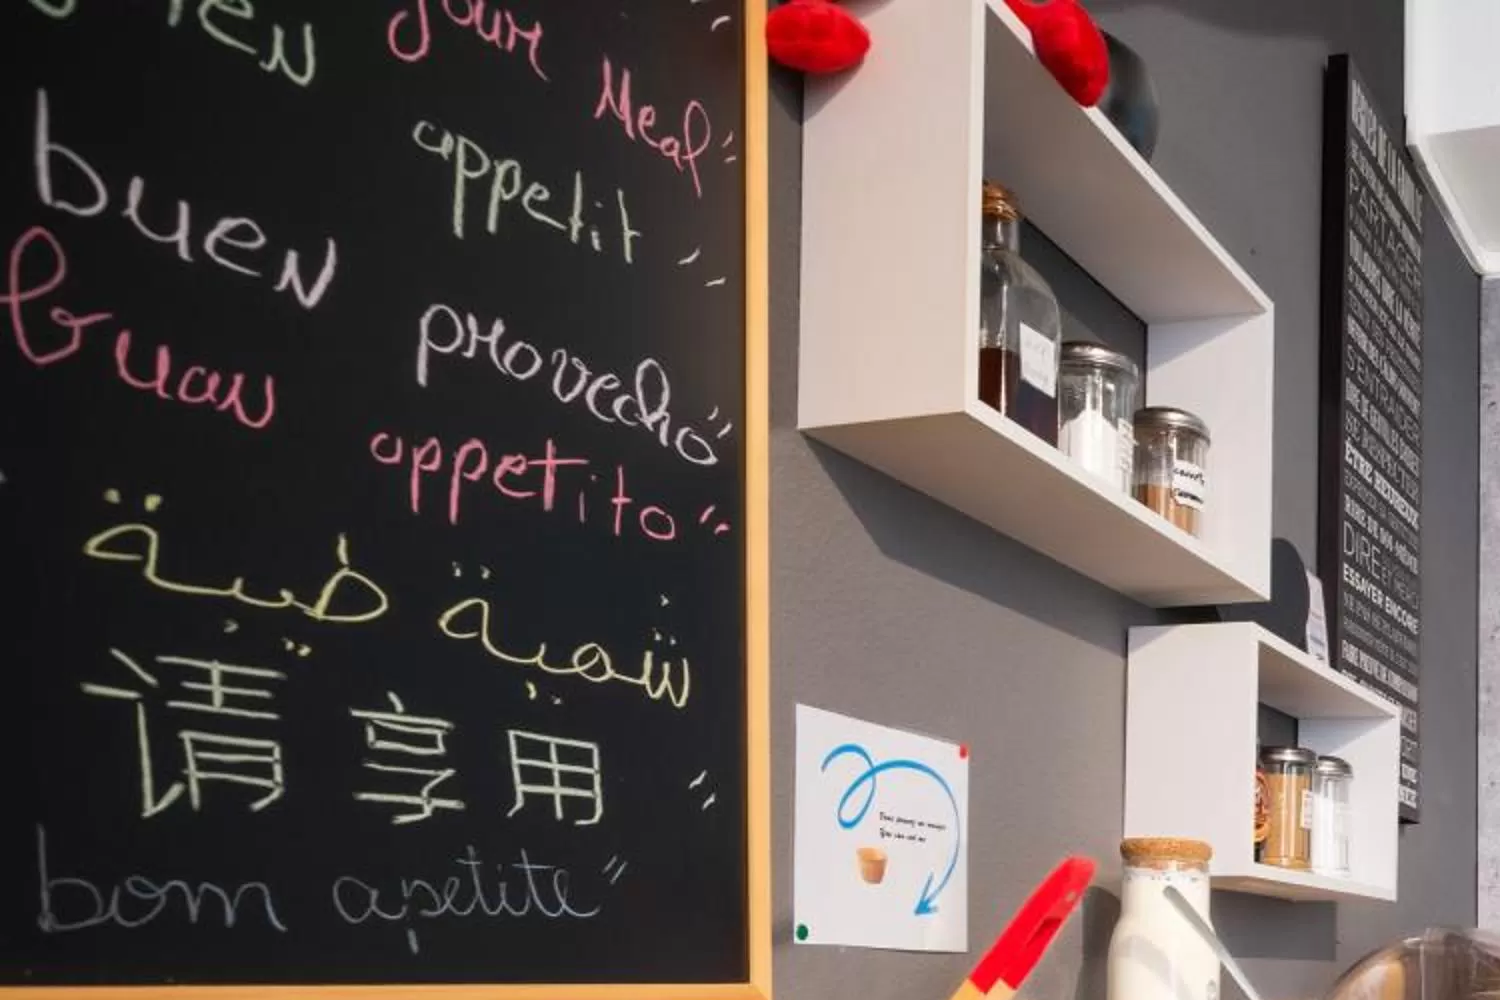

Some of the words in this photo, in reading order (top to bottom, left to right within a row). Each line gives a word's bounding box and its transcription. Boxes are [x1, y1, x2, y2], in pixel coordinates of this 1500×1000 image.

[1343, 518, 1381, 583] DIRE
[1343, 560, 1383, 611] ESSAYER
[36, 823, 288, 934] bom
